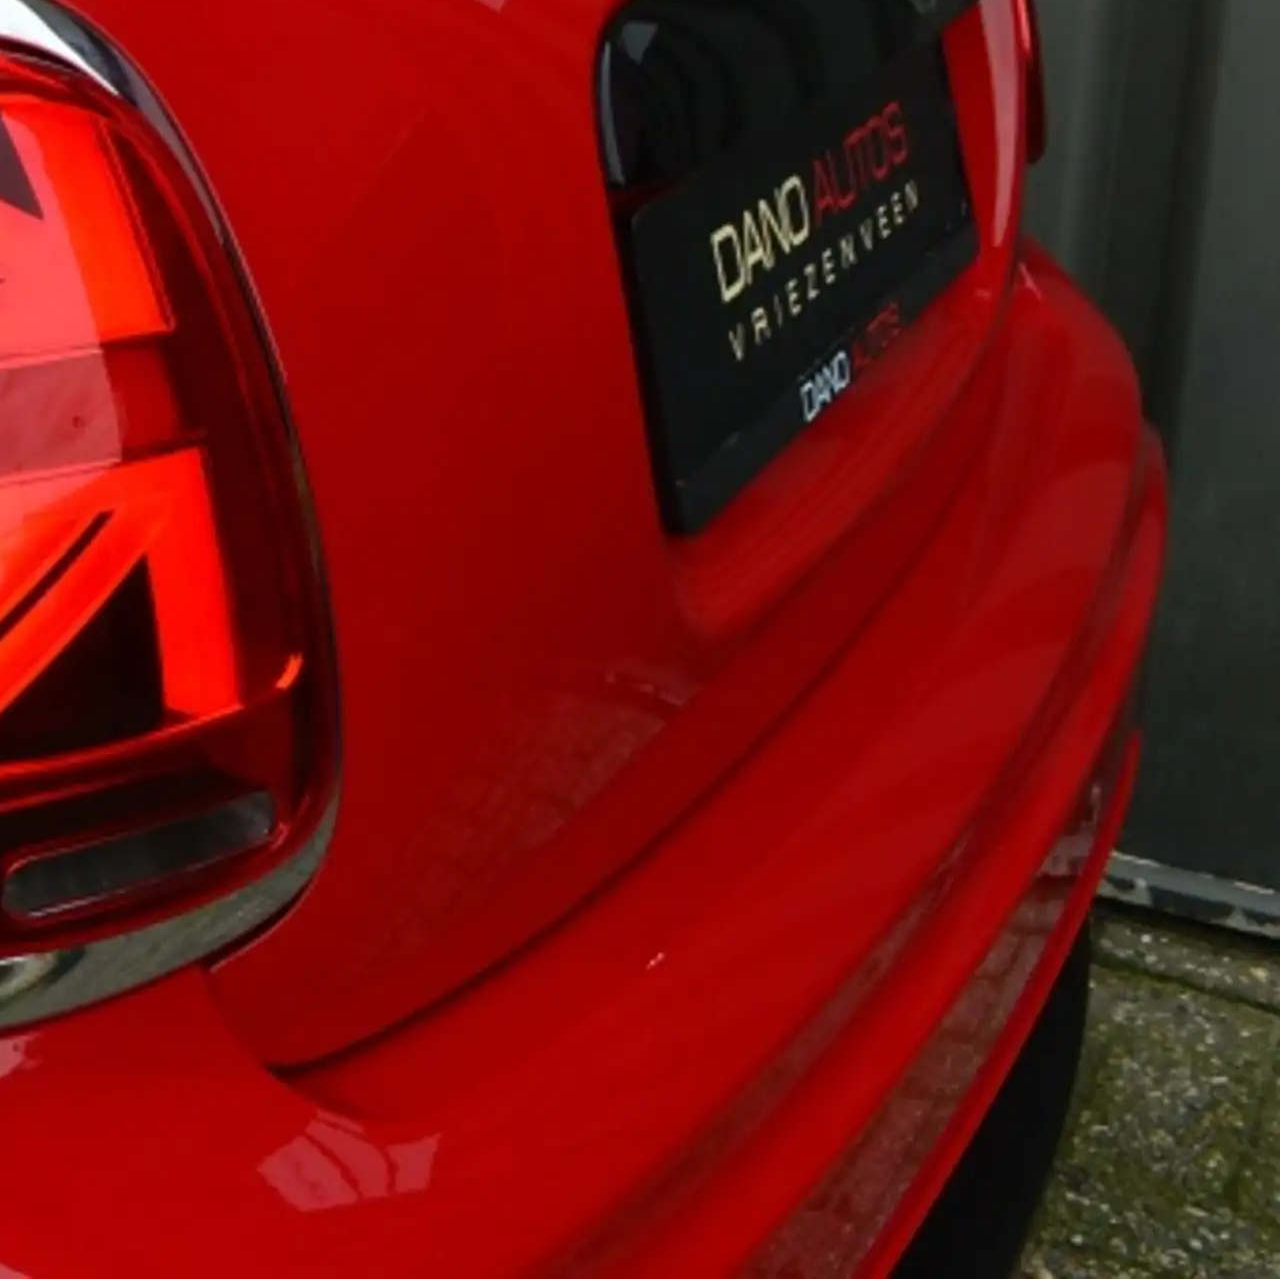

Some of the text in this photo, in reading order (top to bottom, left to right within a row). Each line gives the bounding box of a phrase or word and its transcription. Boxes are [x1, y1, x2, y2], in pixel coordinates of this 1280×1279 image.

[710, 100, 910, 304] DANO AUTOS
[728, 179, 920, 360] VRIEZENVEEN
[799, 349, 852, 423] DANO
